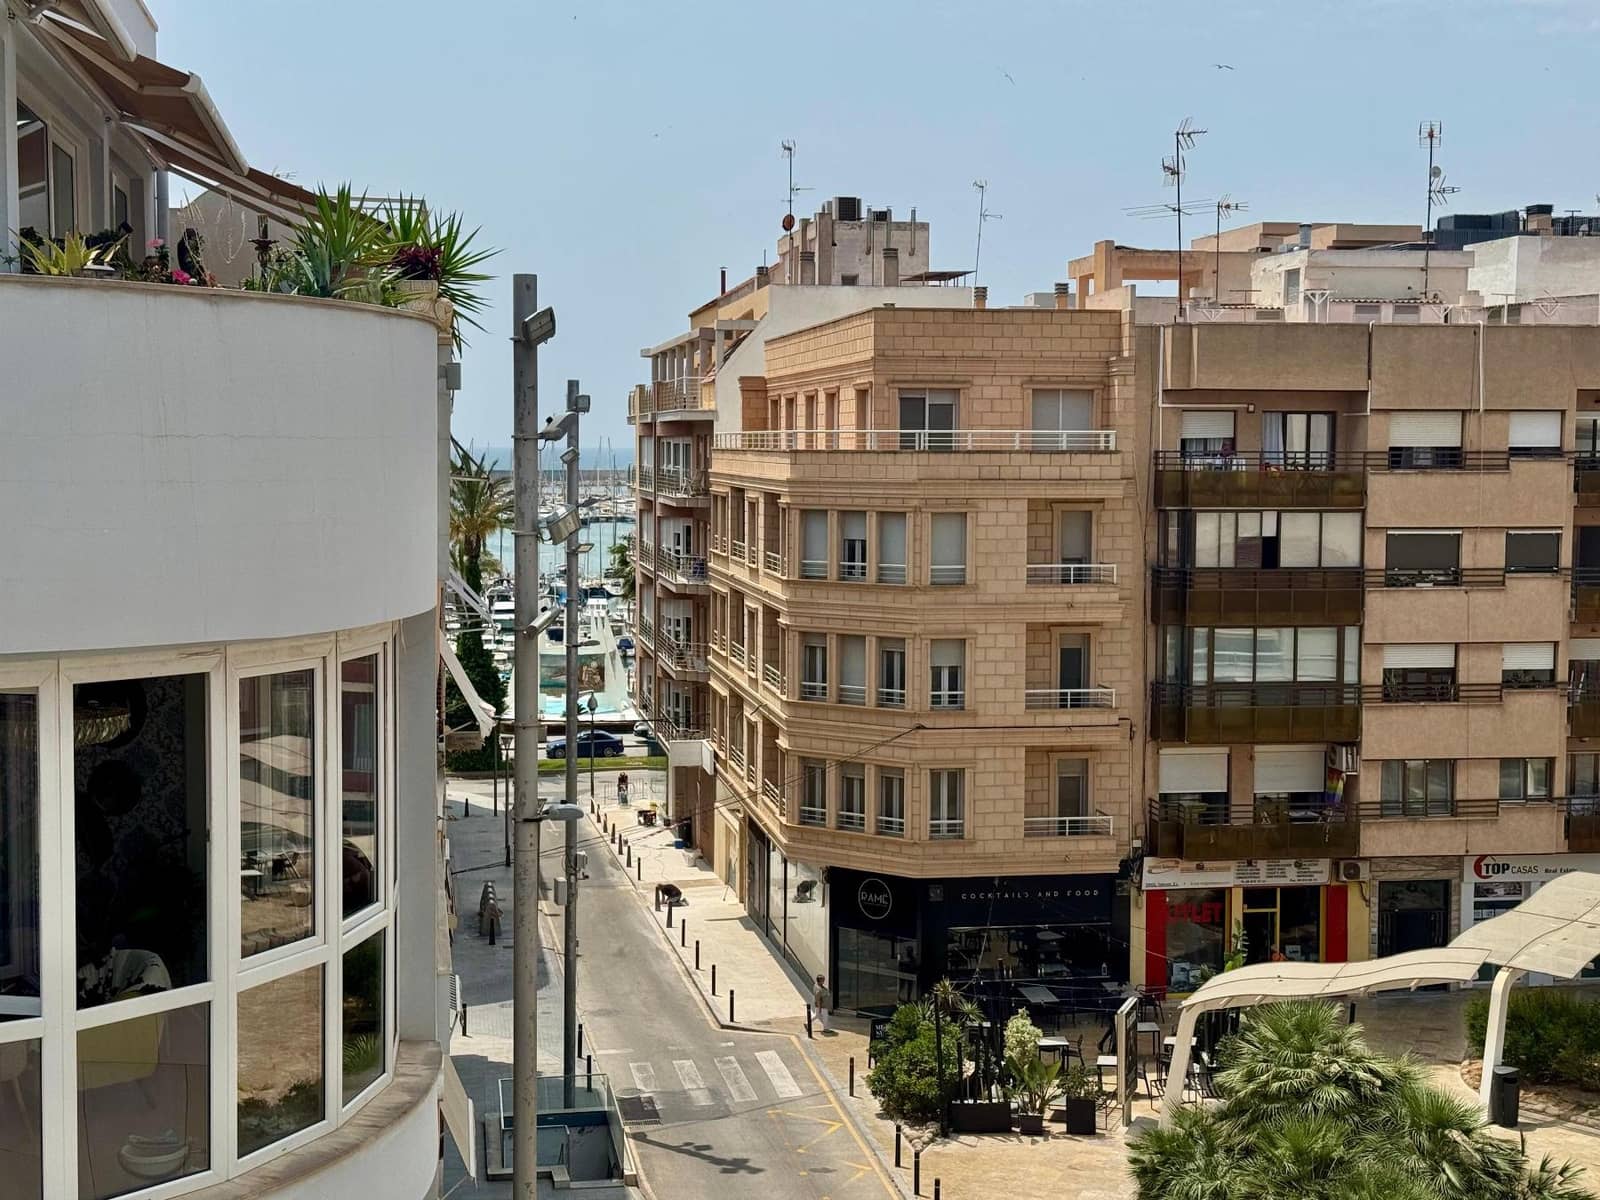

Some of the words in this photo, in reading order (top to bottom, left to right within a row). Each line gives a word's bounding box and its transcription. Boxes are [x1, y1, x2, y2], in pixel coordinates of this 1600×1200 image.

[1484, 863, 1510, 875] TOP
[1511, 865, 1539, 874] CASAS
[961, 892, 1030, 900] COCKTAILS
[1037, 890, 1060, 898] AND
[1066, 889, 1099, 897] FOOD
